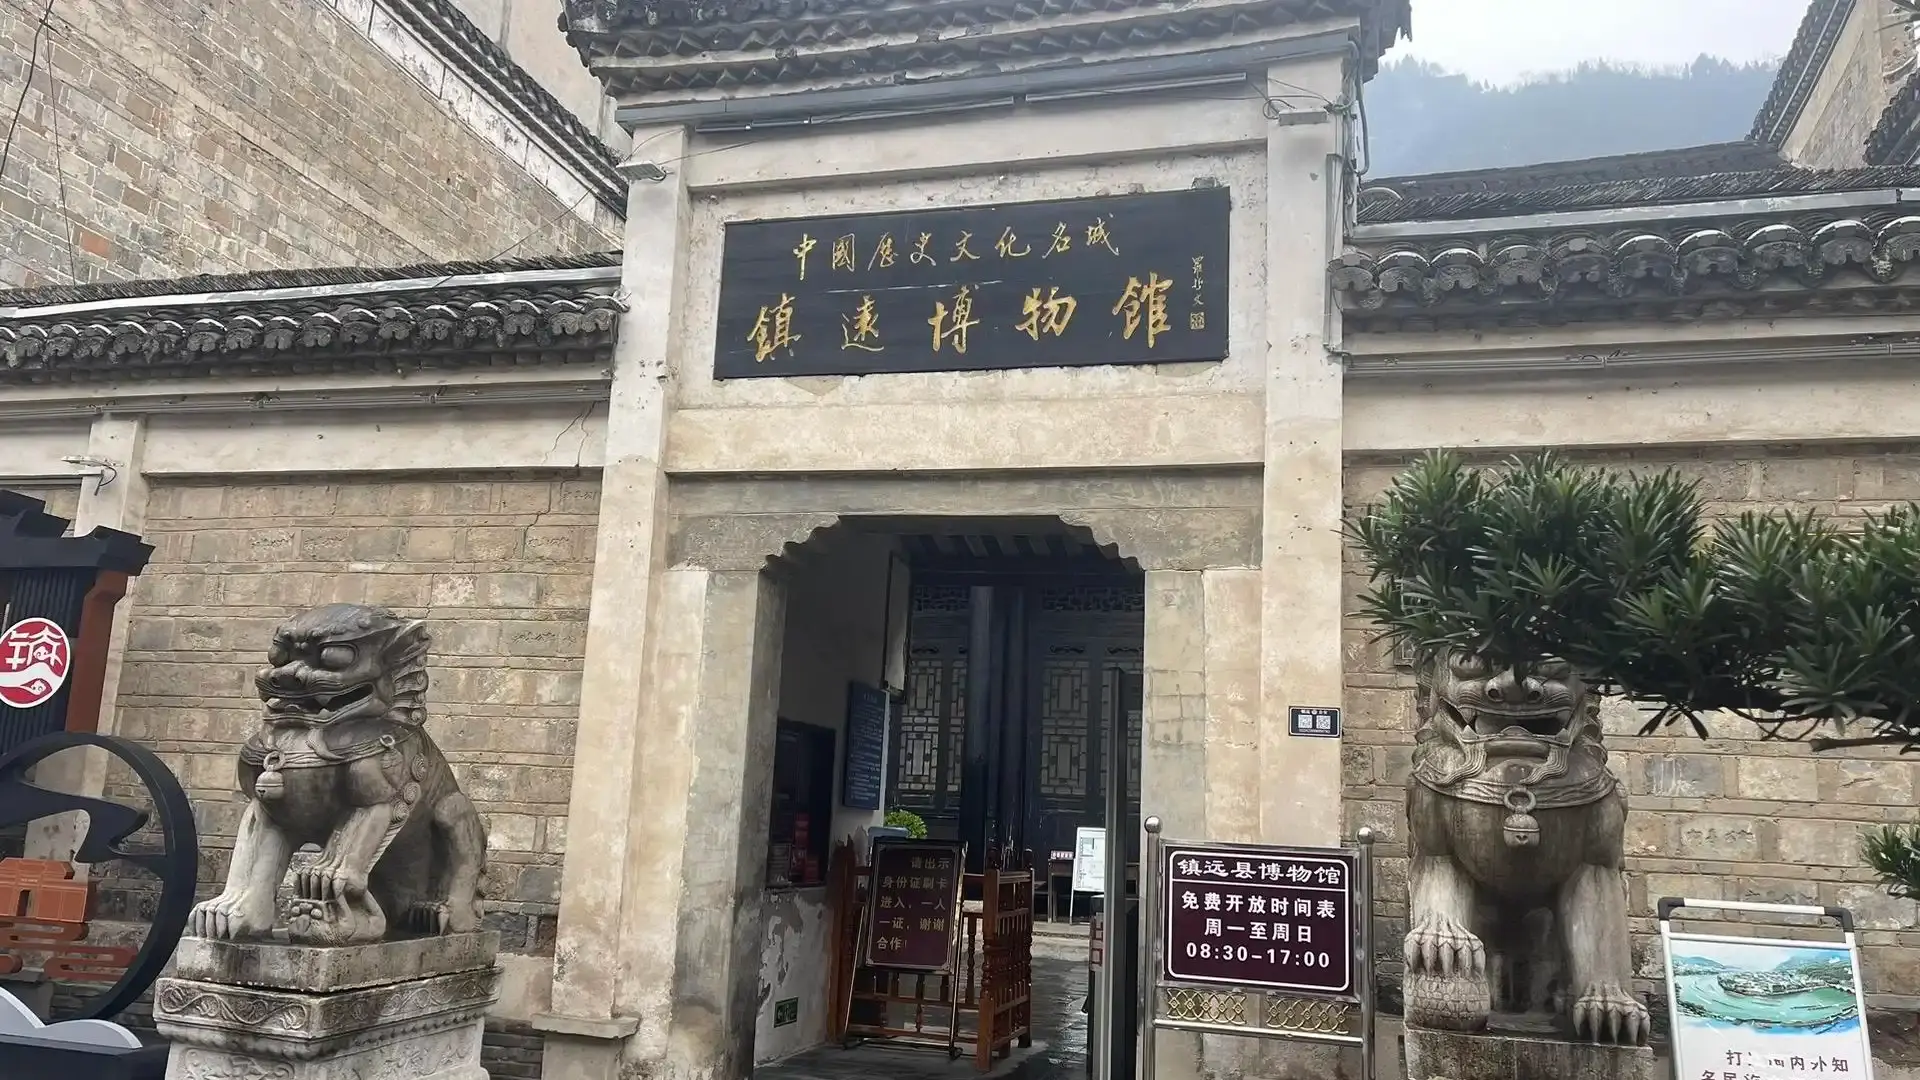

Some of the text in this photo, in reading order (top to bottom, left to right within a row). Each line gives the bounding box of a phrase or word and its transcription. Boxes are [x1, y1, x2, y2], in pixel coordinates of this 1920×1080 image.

[911, 856, 953, 869] 请出示
[1177, 858, 1341, 885] 镇远县博物馆
[882, 875, 949, 889] 身份证刷卡
[1181, 890, 1336, 919] 免费开放时间表
[1204, 917, 1312, 943] 周一至周日
[1186, 942, 1330, 968] 08:30-17:00
[1726, 1050, 1849, 1072] 打内外知
